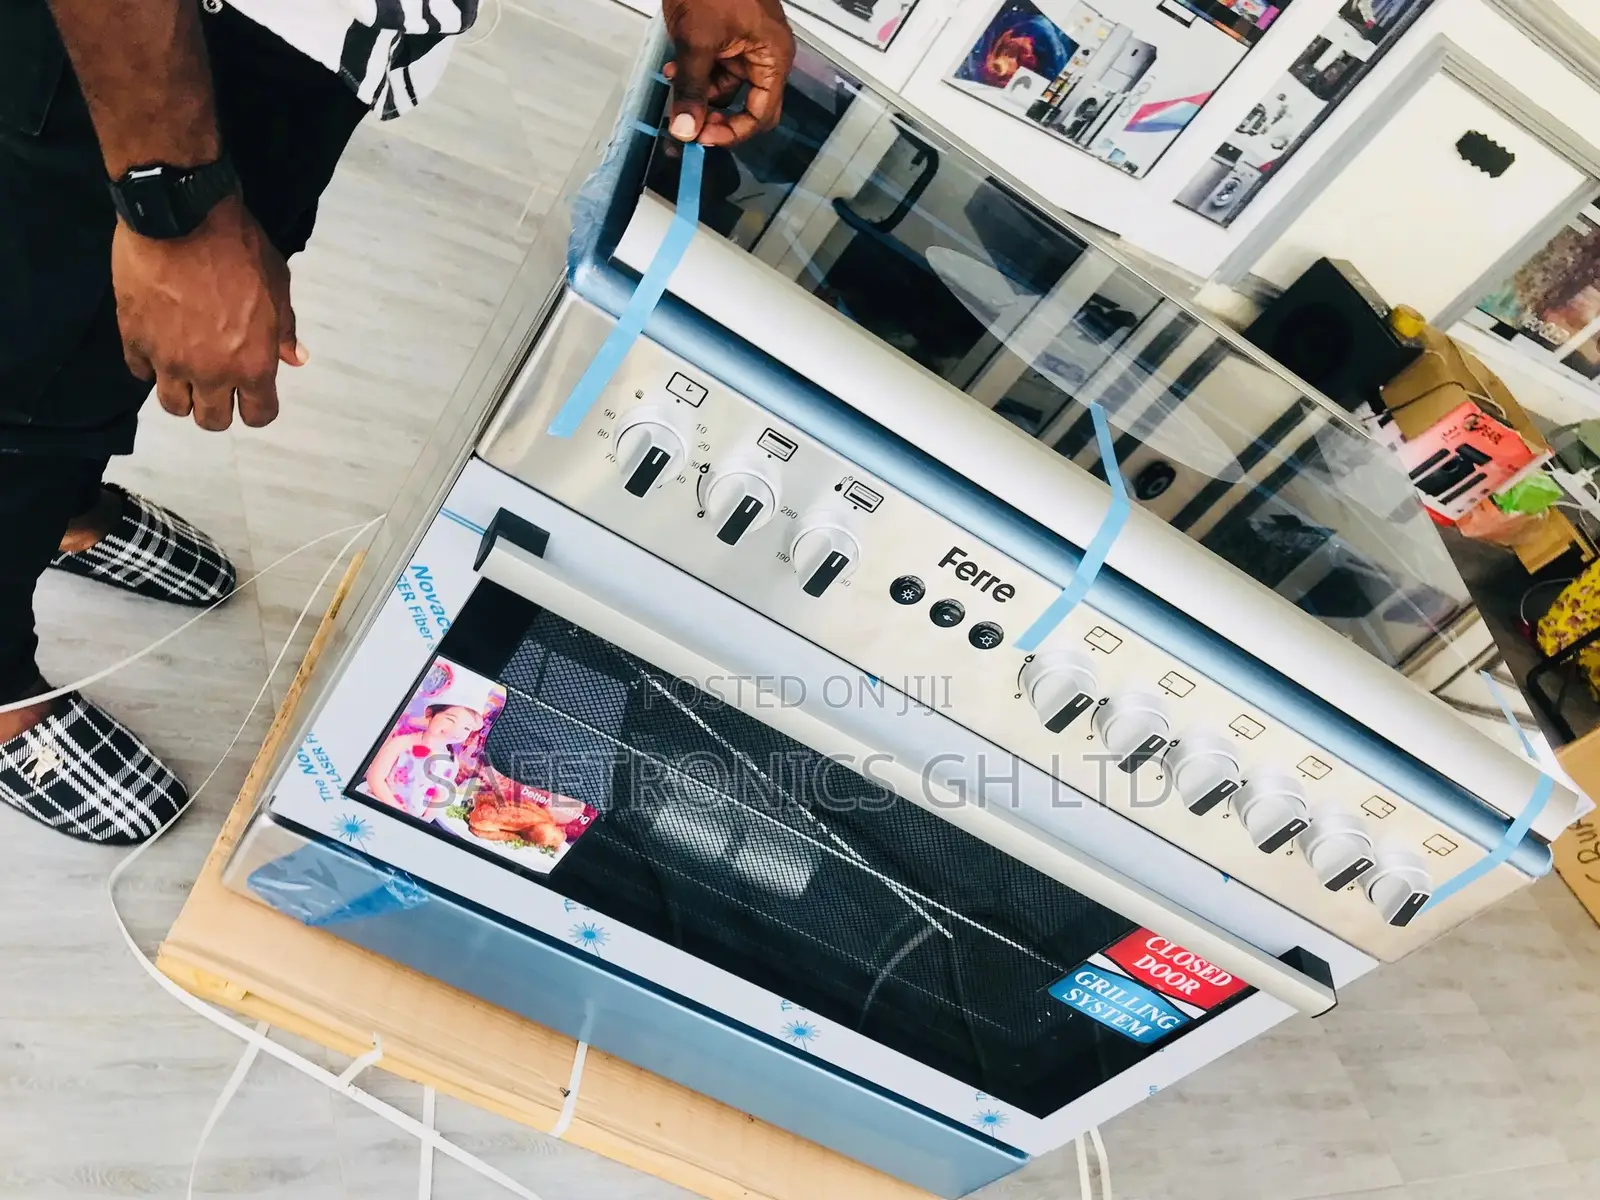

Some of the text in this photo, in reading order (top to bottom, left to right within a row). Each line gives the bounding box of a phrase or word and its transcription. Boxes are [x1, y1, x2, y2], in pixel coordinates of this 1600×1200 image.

[604, 408, 617, 421] 90
[596, 428, 610, 440] 80
[696, 423, 708, 435] 10
[698, 441, 711, 452] 20
[780, 506, 799, 520] 280
[775, 551, 791, 563] 190
[937, 546, 1016, 603] Ferre
[408, 605, 434, 640] Fiber
[311, 746, 342, 783] LASER
[315, 779, 334, 803] The
[521, 786, 551, 805] better
[1145, 936, 1233, 987] CLOSED
[1132, 954, 1201, 996] DOOR
[1074, 970, 1181, 1030] GRILLING
[1062, 988, 1152, 1038] SYSTEM
